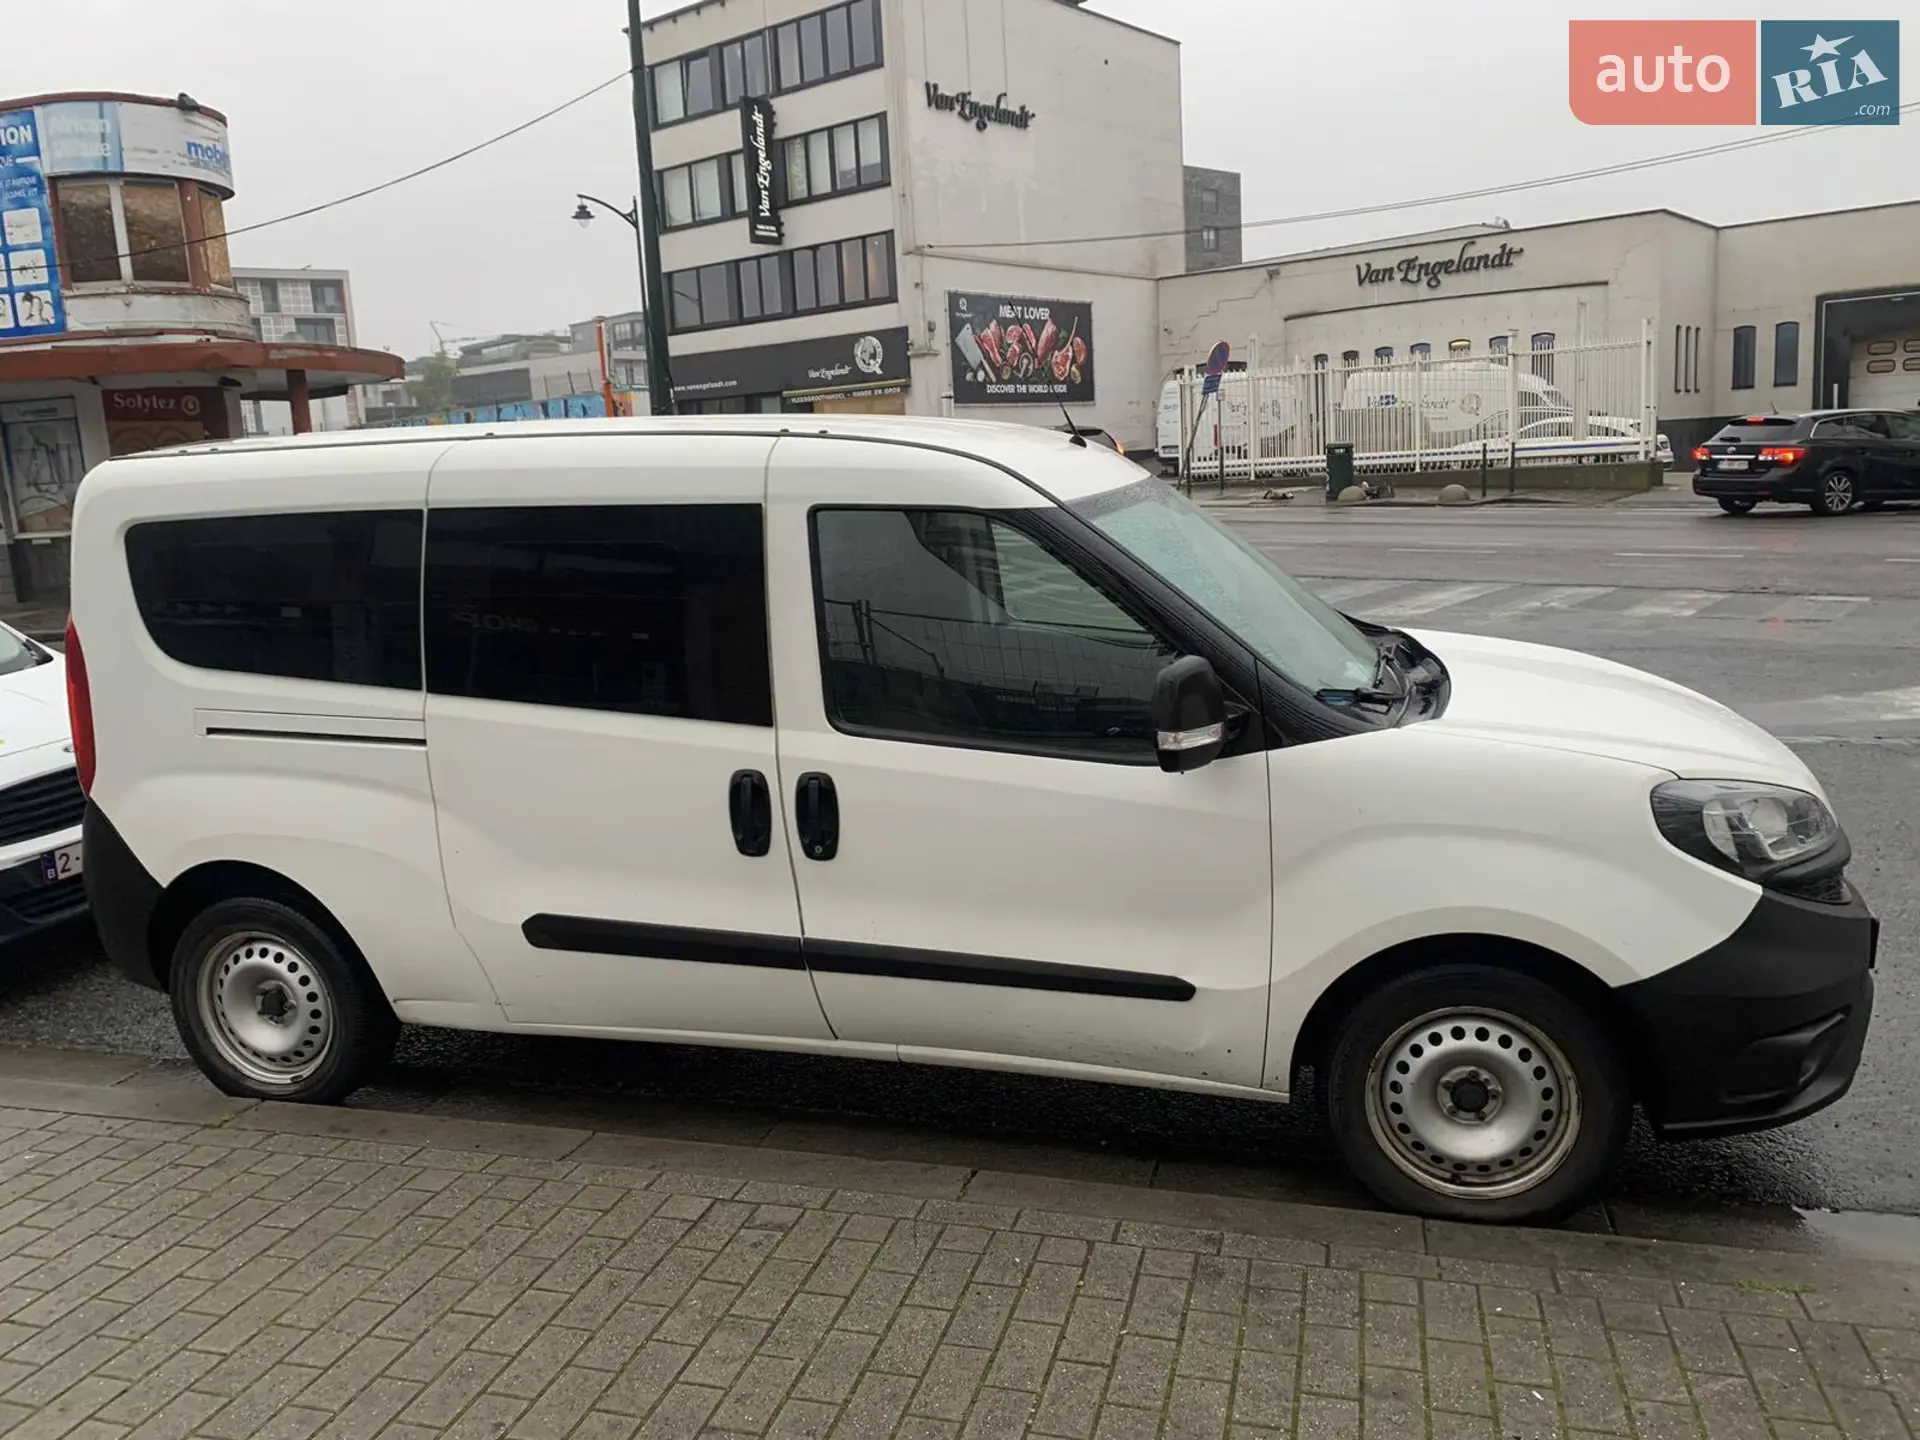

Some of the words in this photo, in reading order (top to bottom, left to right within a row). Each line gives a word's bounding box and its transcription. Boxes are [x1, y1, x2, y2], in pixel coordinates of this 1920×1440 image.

[924, 80, 956, 112] Van
[955, 90, 1036, 132] Engelandt
[750, 105, 772, 188] Engelandt
[758, 189, 771, 217] Van
[1355, 262, 1395, 287] Van
[1396, 241, 1524, 289] Engelandt
[999, 305, 1022, 319] MEAT
[1024, 306, 1051, 320] LOVER
[986, 384, 1016, 394] DISCOVER
[1016, 384, 1028, 394] THE
[1028, 384, 1049, 394] WORLD
